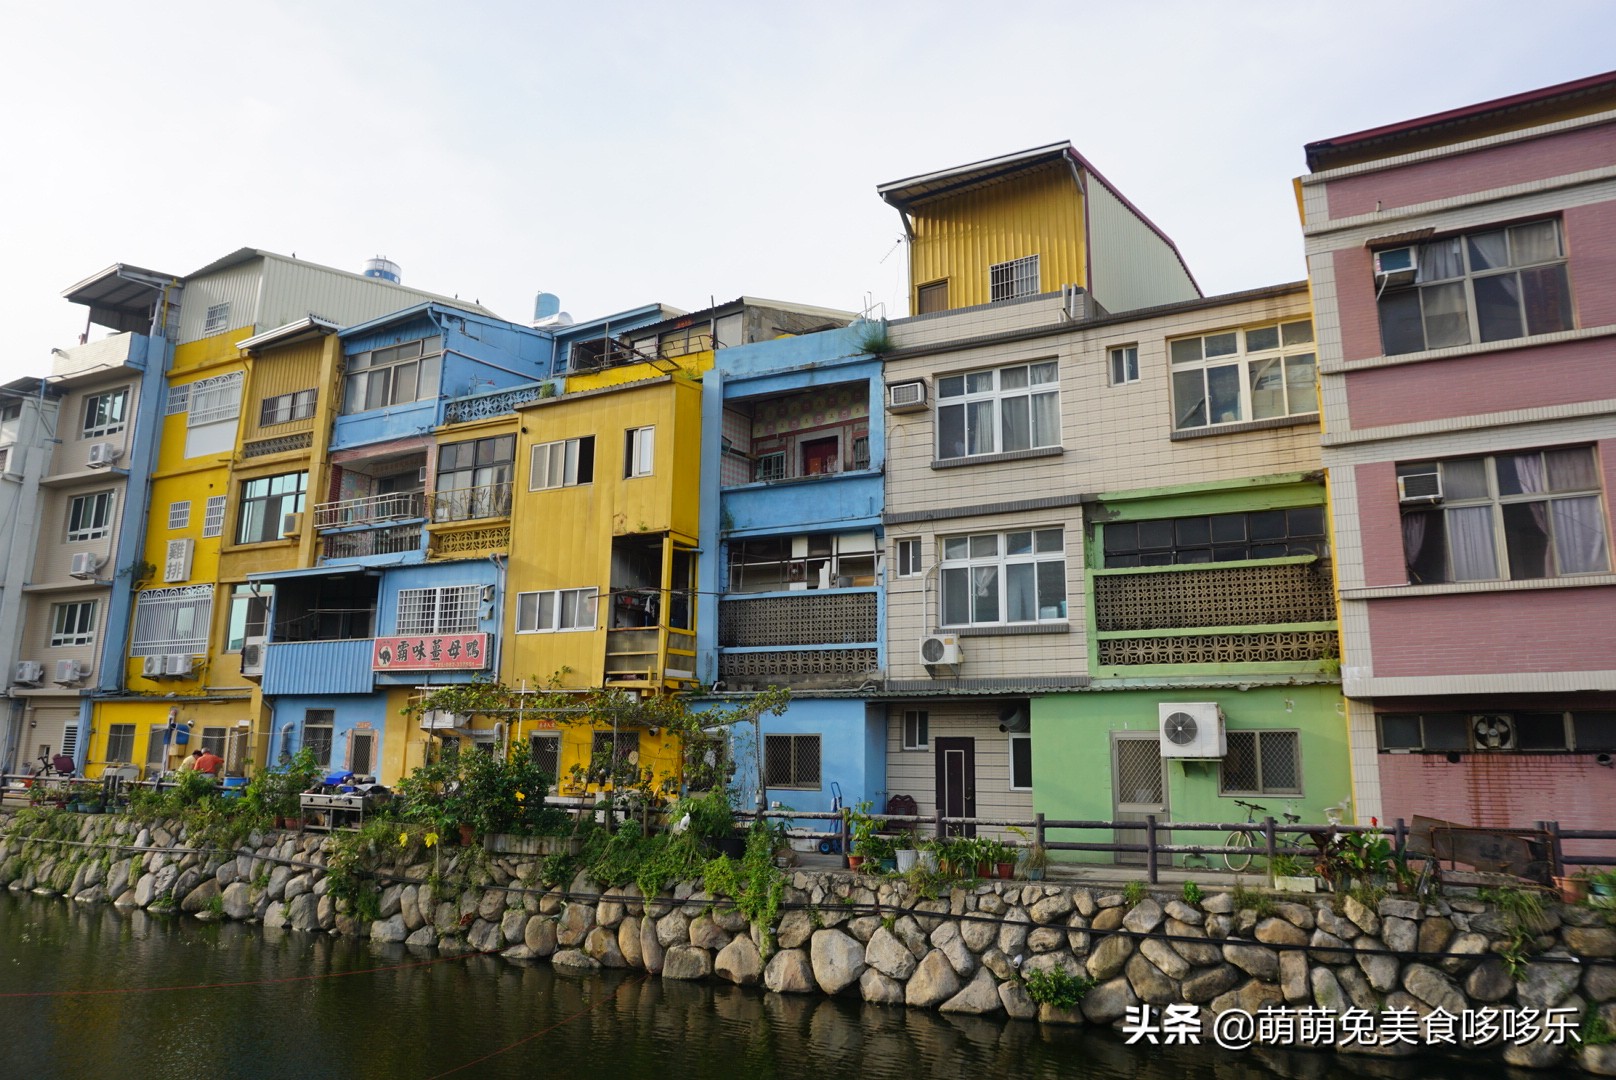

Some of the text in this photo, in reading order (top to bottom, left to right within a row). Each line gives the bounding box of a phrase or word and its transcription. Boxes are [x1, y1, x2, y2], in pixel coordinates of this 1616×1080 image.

[395, 639, 480, 662] 霸味薑母鴨
